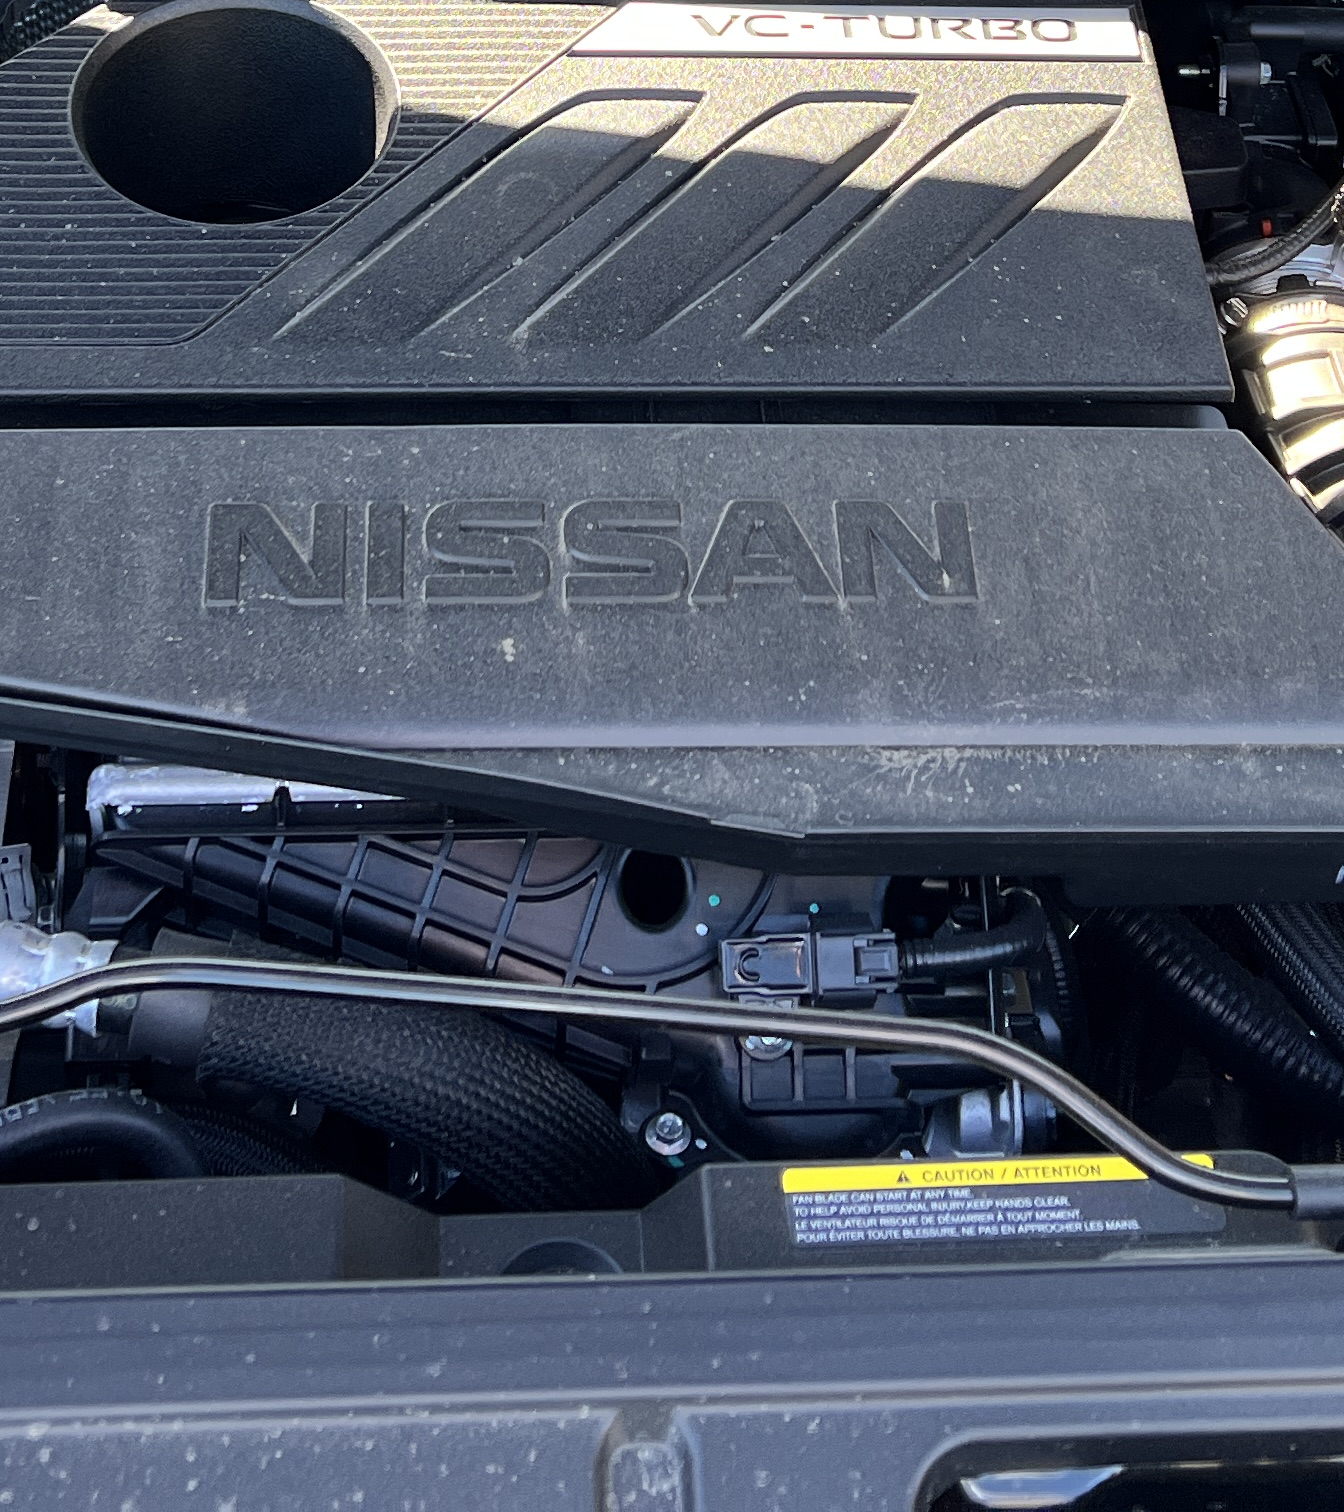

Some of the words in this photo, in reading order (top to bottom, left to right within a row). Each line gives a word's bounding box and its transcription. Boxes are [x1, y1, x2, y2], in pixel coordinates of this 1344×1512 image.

[690, 13, 1079, 44] VC-TURBO
[202, 497, 981, 611] NISSAN
[922, 1168, 994, 1183] CAUTION
[1014, 1164, 1102, 1179] ATTENTION
[792, 1194, 813, 1205] FAN
[815, 1192, 849, 1204] BLADE
[851, 1191, 874, 1203] CAN
[876, 1190, 907, 1202] START
[910, 1189, 923, 1200] AT
[924, 1188, 946, 1199] ANY
[795, 1206, 807, 1217] TO
[810, 1205, 837, 1217] HELP
[840, 1204, 871, 1216] AVOID
[873, 1201, 930, 1214] PERSONAL
[995, 1196, 1033, 1209] HANDS
[795, 1219, 807, 1231] LE
[809, 1217, 878, 1231] VENTILATEUR
[879, 1216, 919, 1228] RISQUE
[921, 1214, 936, 1226] DE
[937, 1211, 994, 1226] DÉMARRER
[1006, 1210, 1033, 1223] TOUT
[797, 1232, 828, 1244] POUR
[829, 1229, 866, 1243] ÉVITER
[866, 1229, 902, 1241] TOUTE
[961, 1225, 977, 1237] NE
[978, 1224, 999, 1236] PAS
[1000, 1223, 1016, 1236] EN
[1017, 1221, 1083, 1235] APPROCHER
[1084, 1220, 1104, 1233] LES
